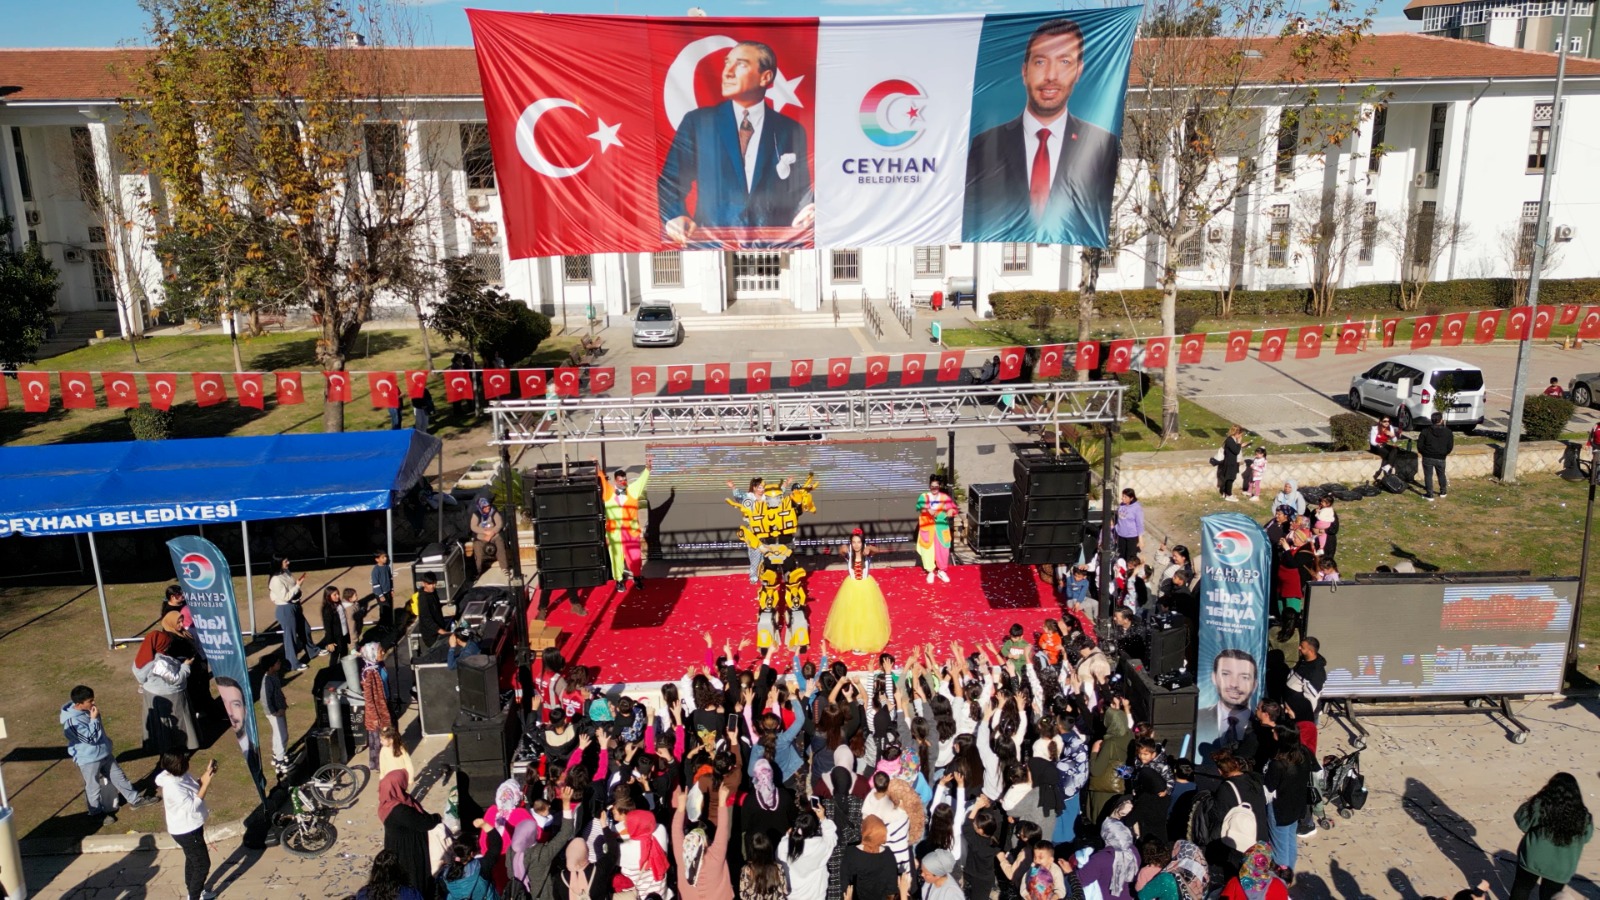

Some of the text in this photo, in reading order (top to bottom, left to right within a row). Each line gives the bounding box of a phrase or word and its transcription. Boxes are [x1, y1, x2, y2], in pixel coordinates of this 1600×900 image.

[842, 157, 936, 174] CEYHAN
[858, 175, 920, 184] BELEDİYESİ
[100, 501, 238, 526] BELEDİYESİ
